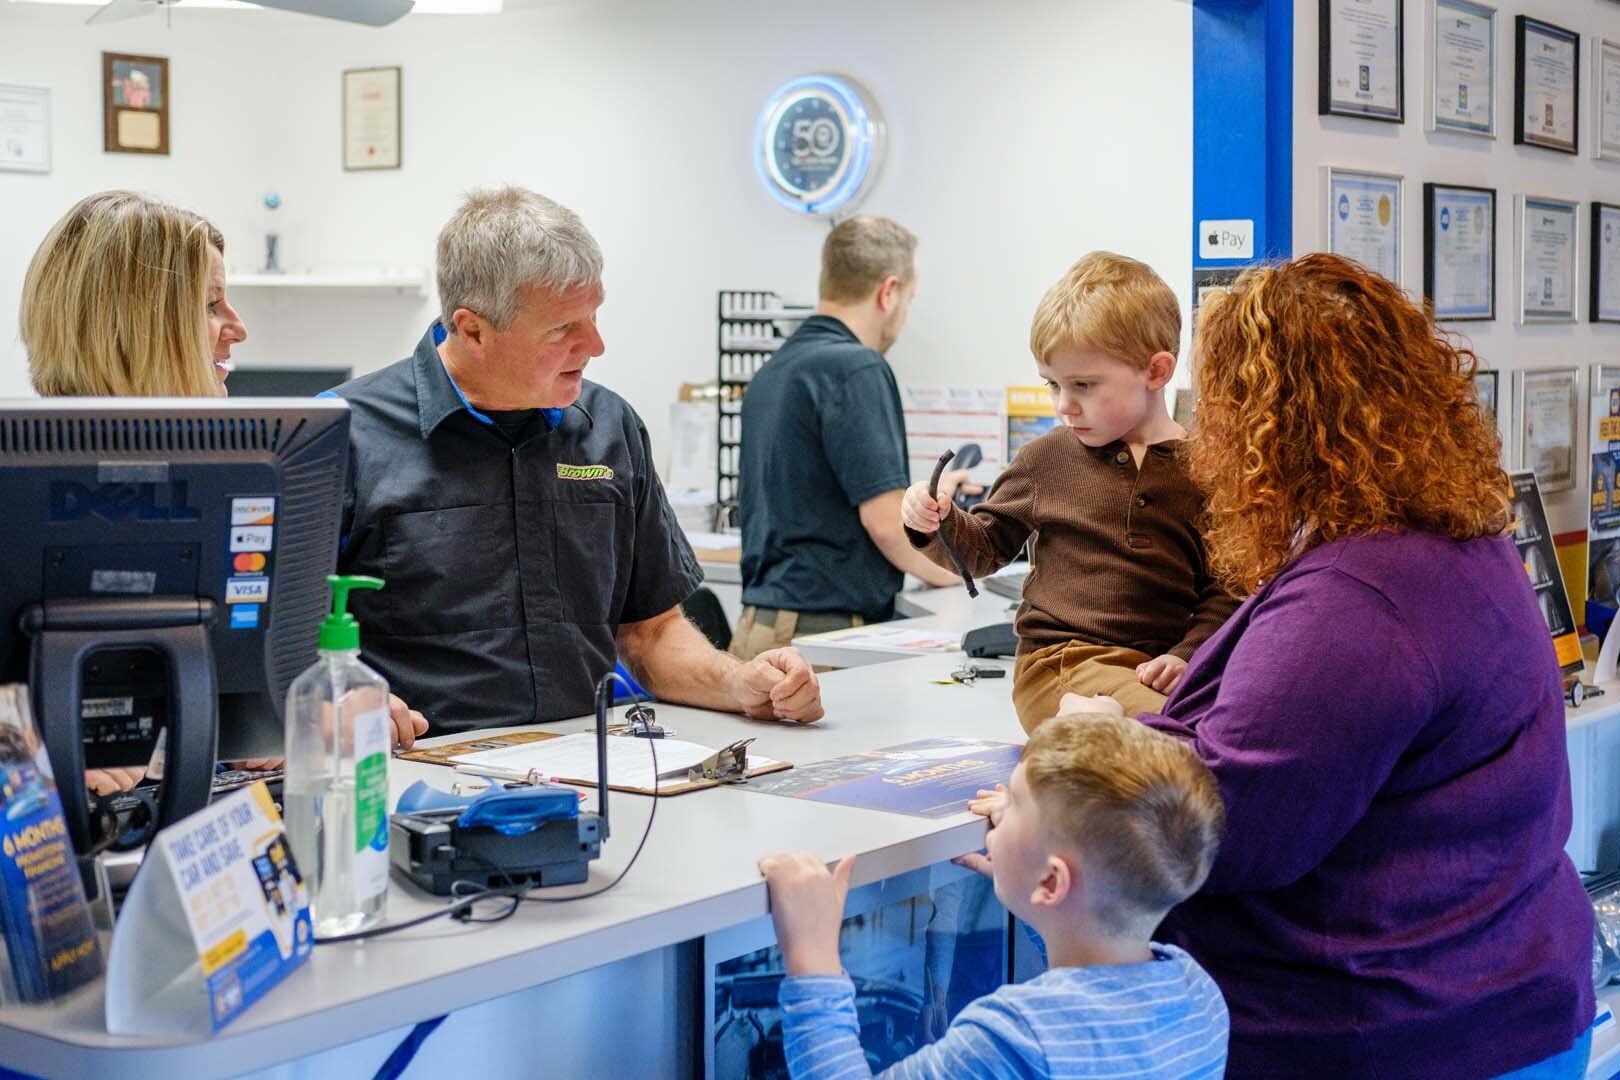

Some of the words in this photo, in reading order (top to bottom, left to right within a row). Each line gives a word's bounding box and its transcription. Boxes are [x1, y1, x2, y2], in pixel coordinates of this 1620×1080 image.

[792, 118, 841, 158] 50
[1221, 230, 1247, 250] Pay
[49, 479, 203, 523] DELL
[234, 584, 263, 595] VISA
